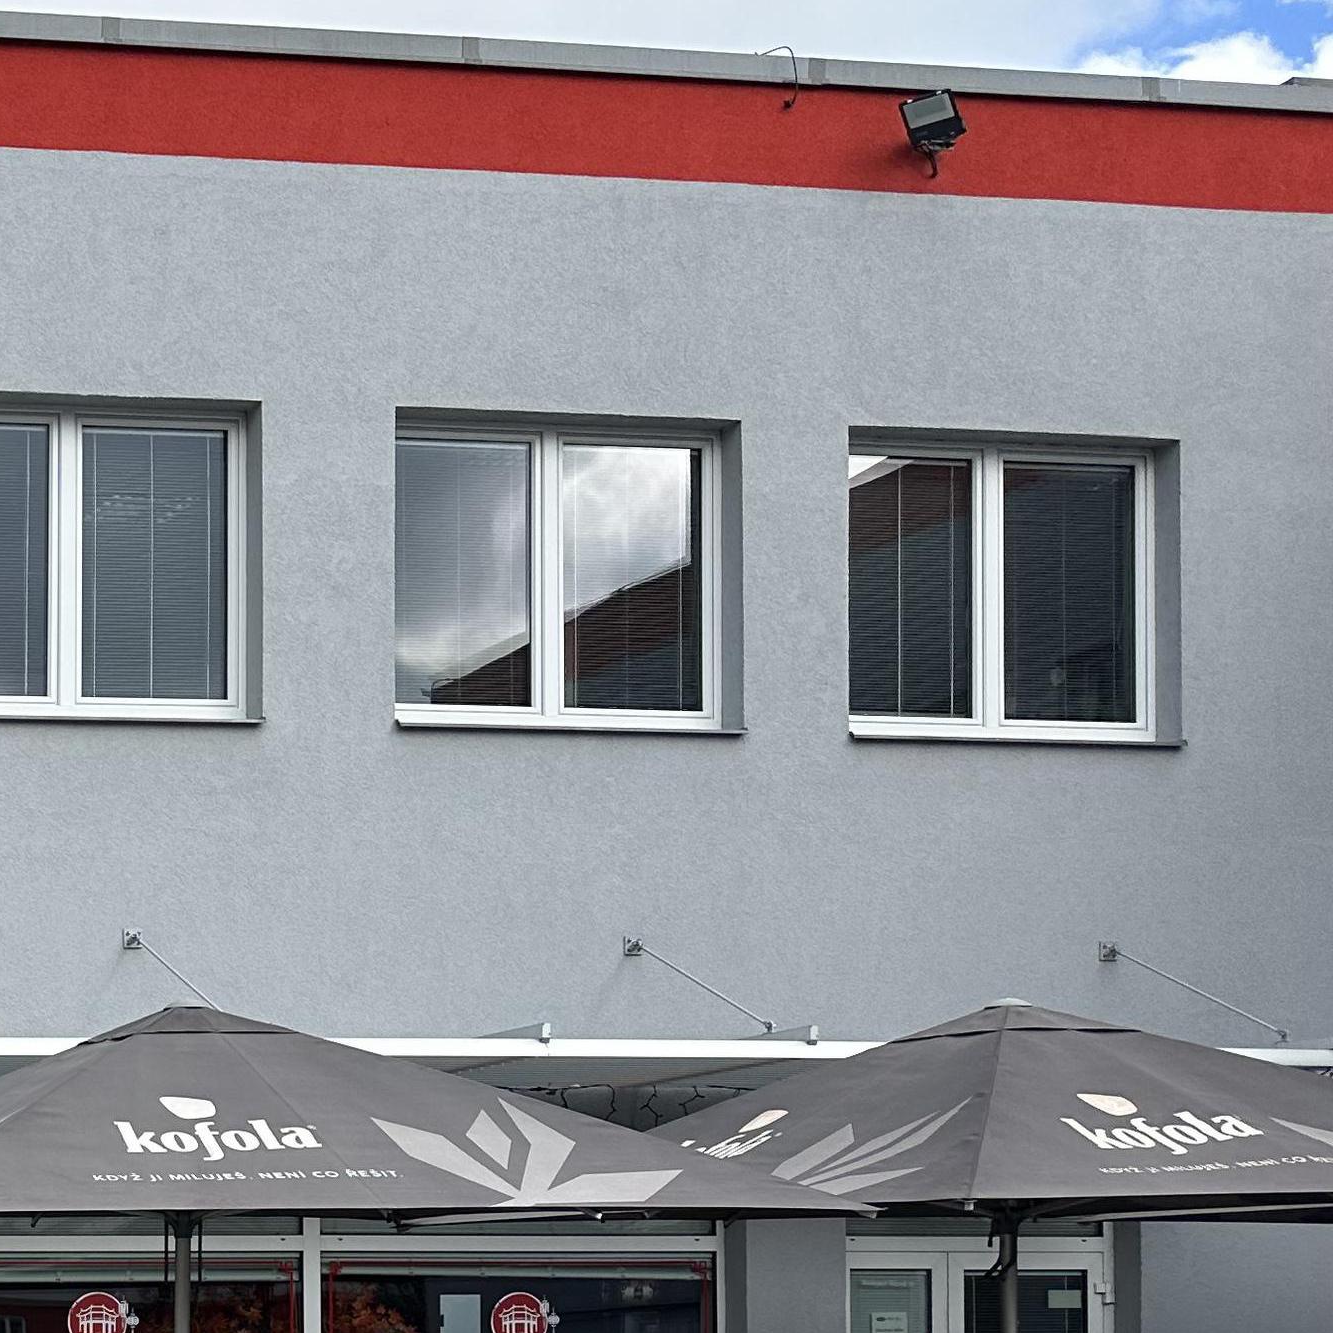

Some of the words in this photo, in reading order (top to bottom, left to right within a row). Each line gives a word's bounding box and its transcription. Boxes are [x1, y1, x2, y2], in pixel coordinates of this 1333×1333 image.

[113, 1119, 323, 1161] kofola
[1059, 1110, 1265, 1155] kofola
[312, 1170, 340, 1178] CO
